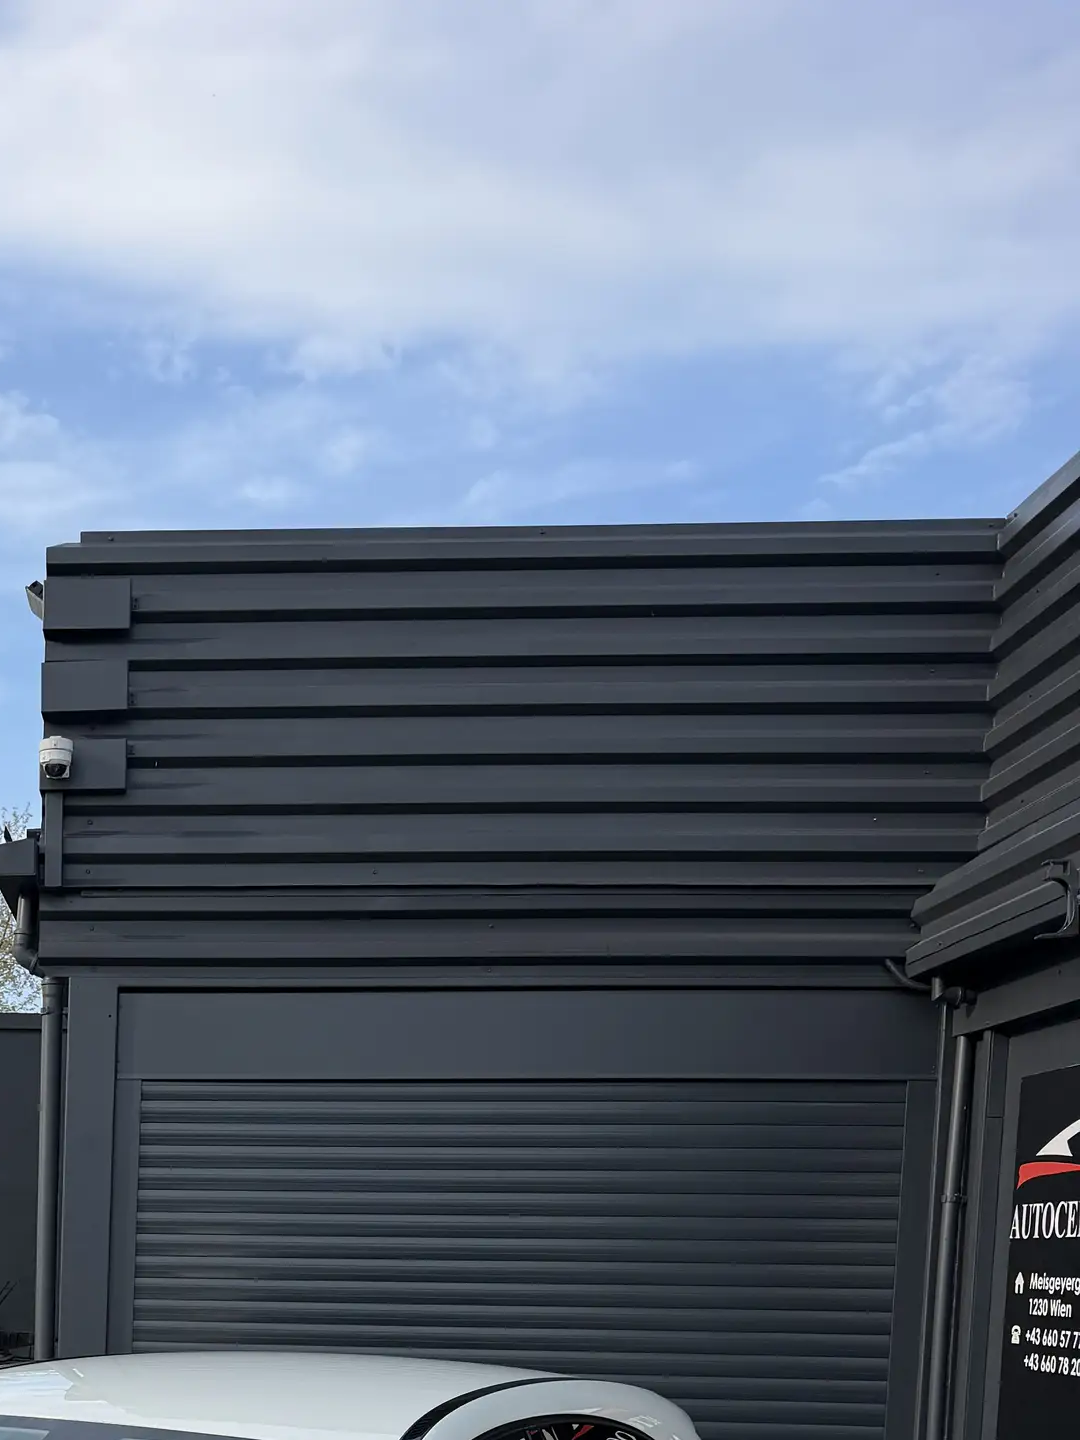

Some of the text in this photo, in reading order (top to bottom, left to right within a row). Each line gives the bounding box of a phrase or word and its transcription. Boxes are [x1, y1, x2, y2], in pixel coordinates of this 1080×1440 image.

[1009, 1200, 1080, 1239] AUTOCE
[1029, 1298, 1072, 1318] 1230 Wien
[1025, 1327, 1041, 1346] +43
[1042, 1328, 1058, 1347] 660
[1059, 1330, 1071, 1348] 57
[1023, 1353, 1039, 1371] +43
[1040, 1354, 1056, 1373] 660
[1058, 1356, 1069, 1375] 78
